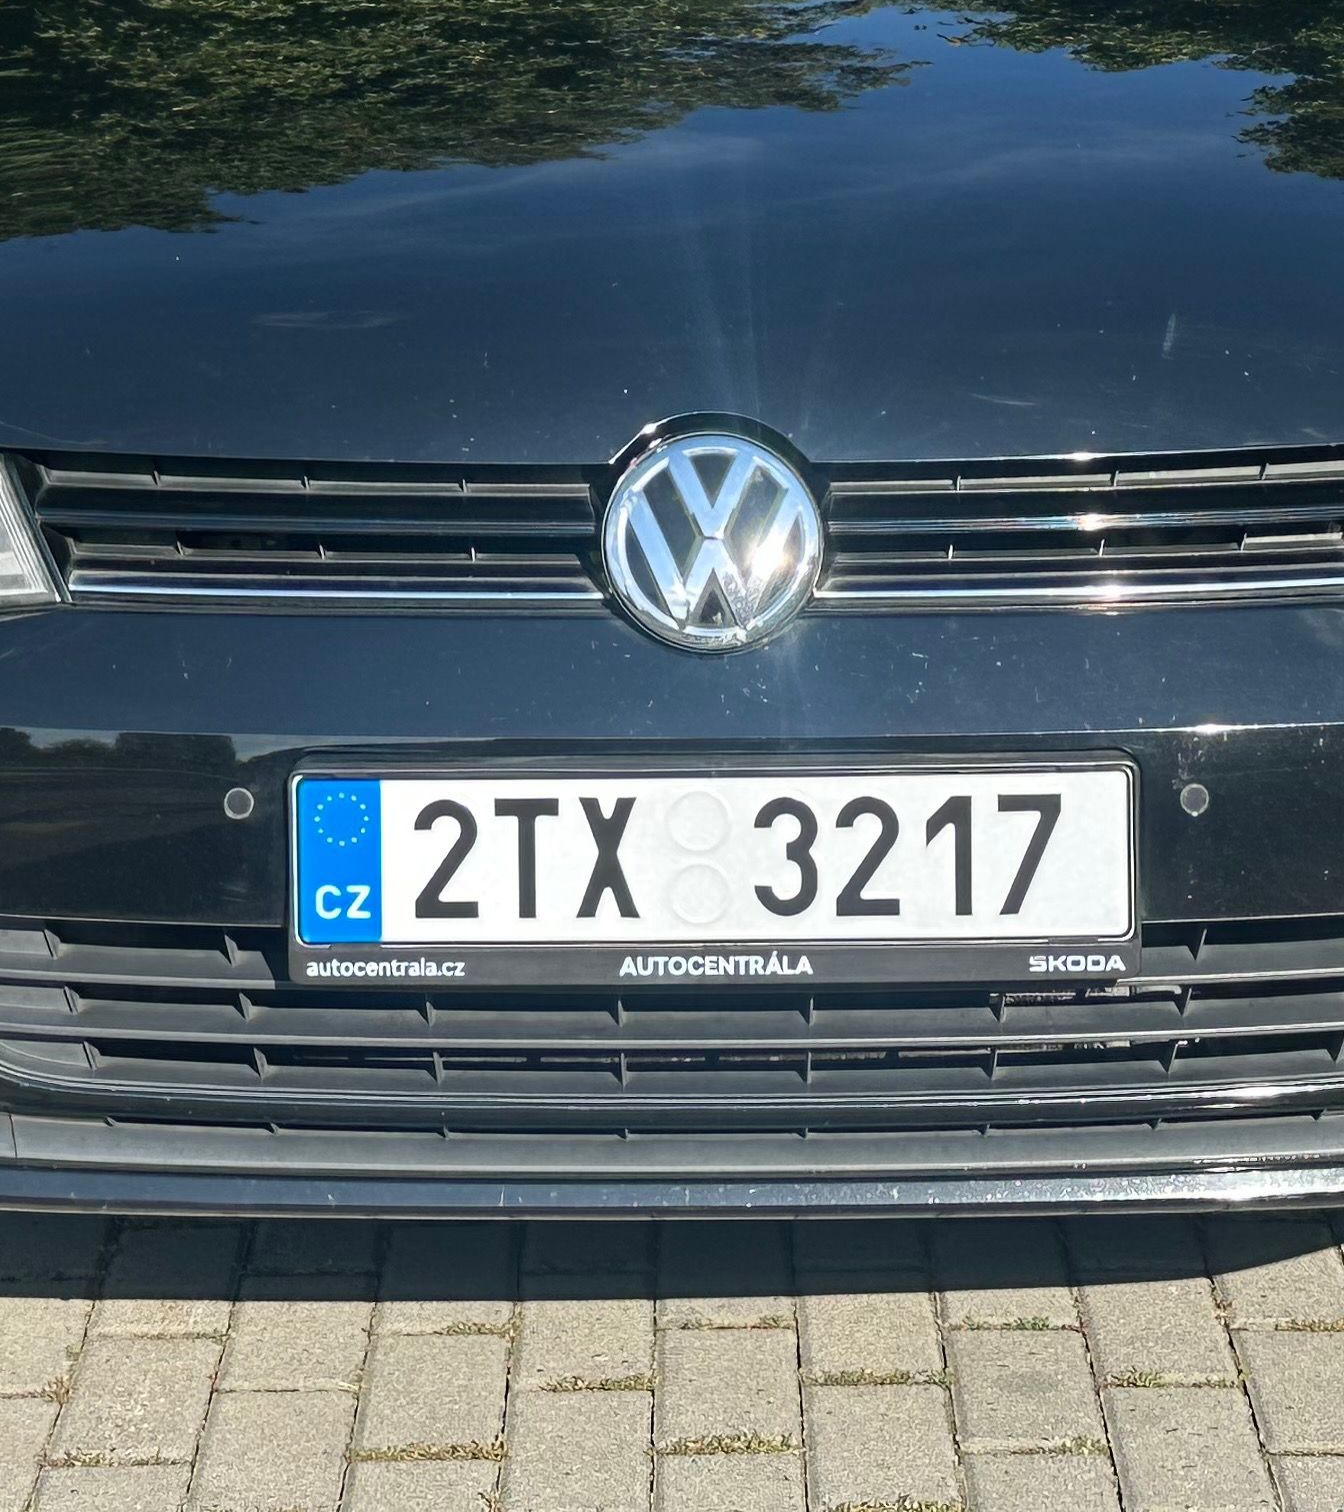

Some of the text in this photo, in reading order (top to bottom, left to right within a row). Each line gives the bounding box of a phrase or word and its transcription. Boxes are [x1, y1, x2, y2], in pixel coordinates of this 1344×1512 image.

[413, 793, 1062, 919] 2TX 3217
[315, 884, 371, 919] CZ
[306, 957, 466, 977] autocentrala.cz
[619, 950, 814, 976] AUTOCENTRÁLA
